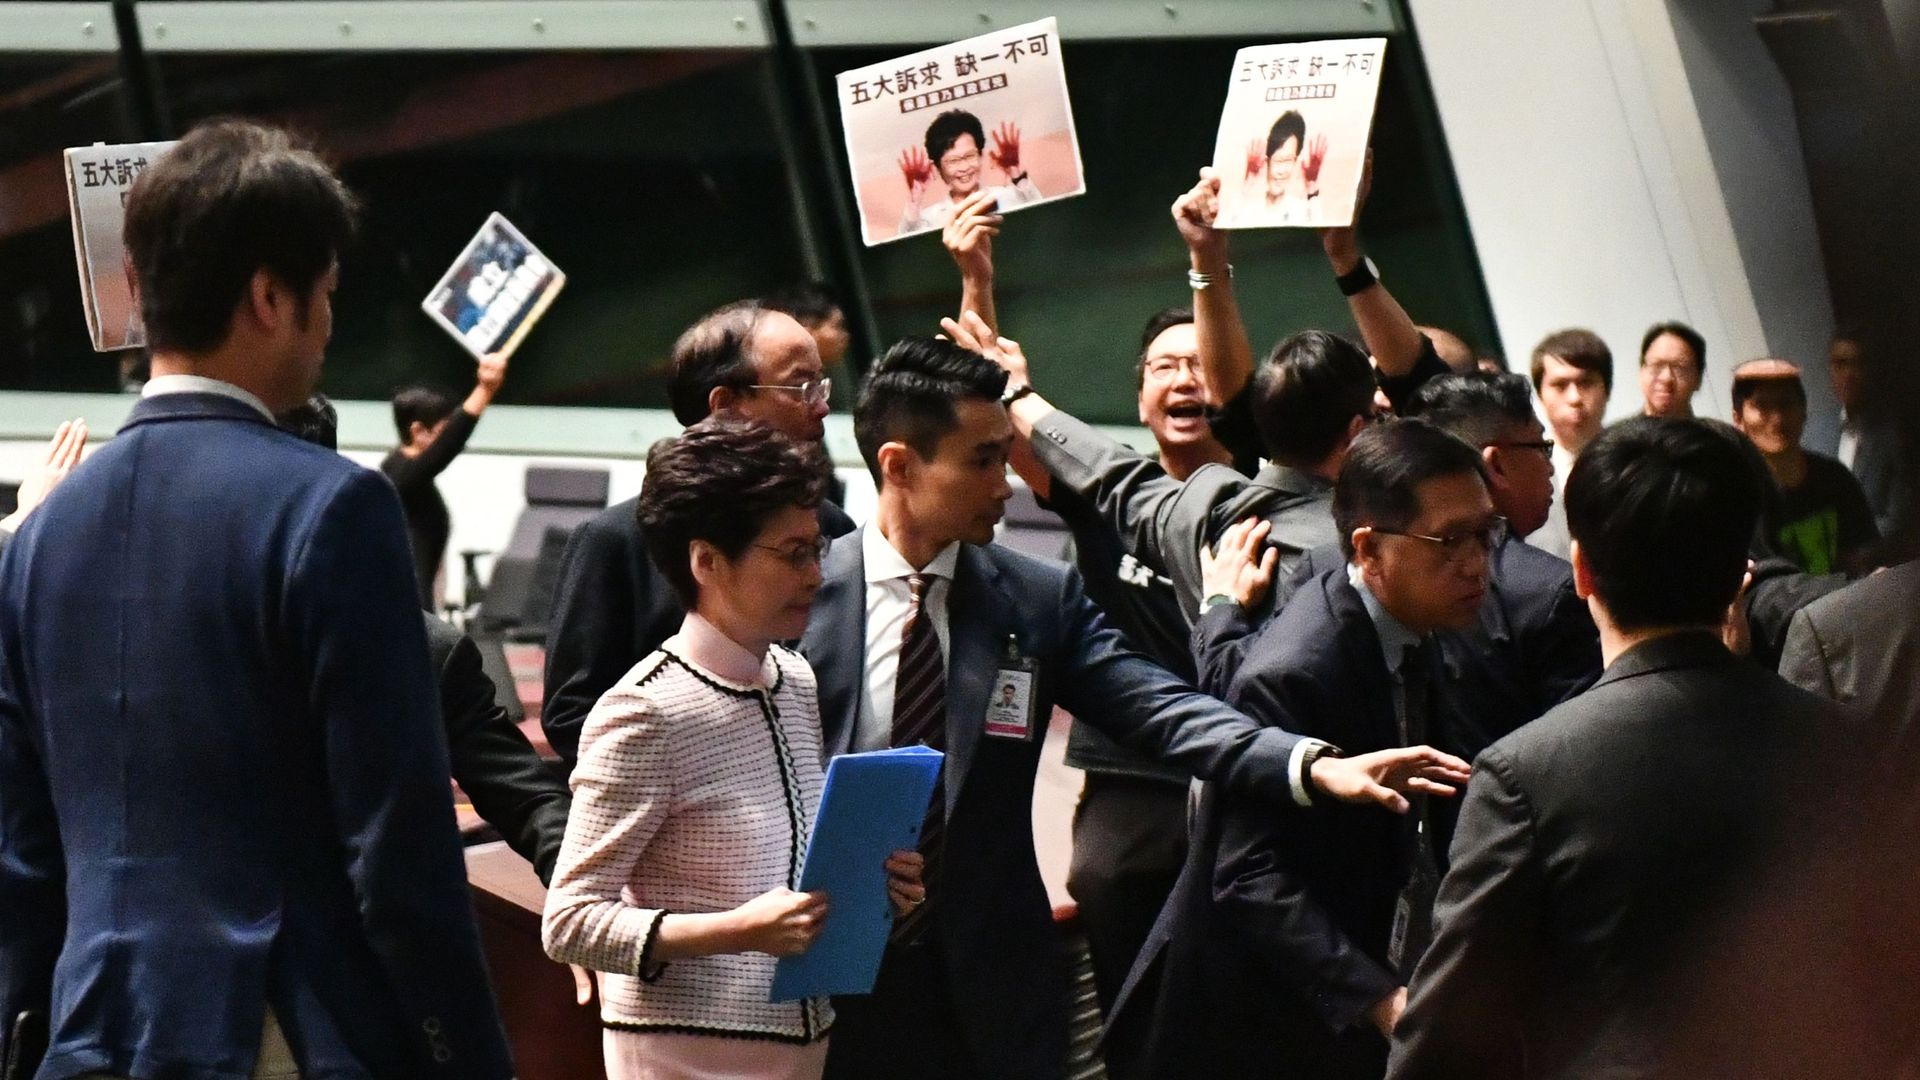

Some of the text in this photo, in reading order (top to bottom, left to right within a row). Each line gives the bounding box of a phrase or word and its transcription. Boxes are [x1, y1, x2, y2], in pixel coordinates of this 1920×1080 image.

[849, 61, 942, 105] 五大訴求
[954, 33, 1049, 77] 缺一不可
